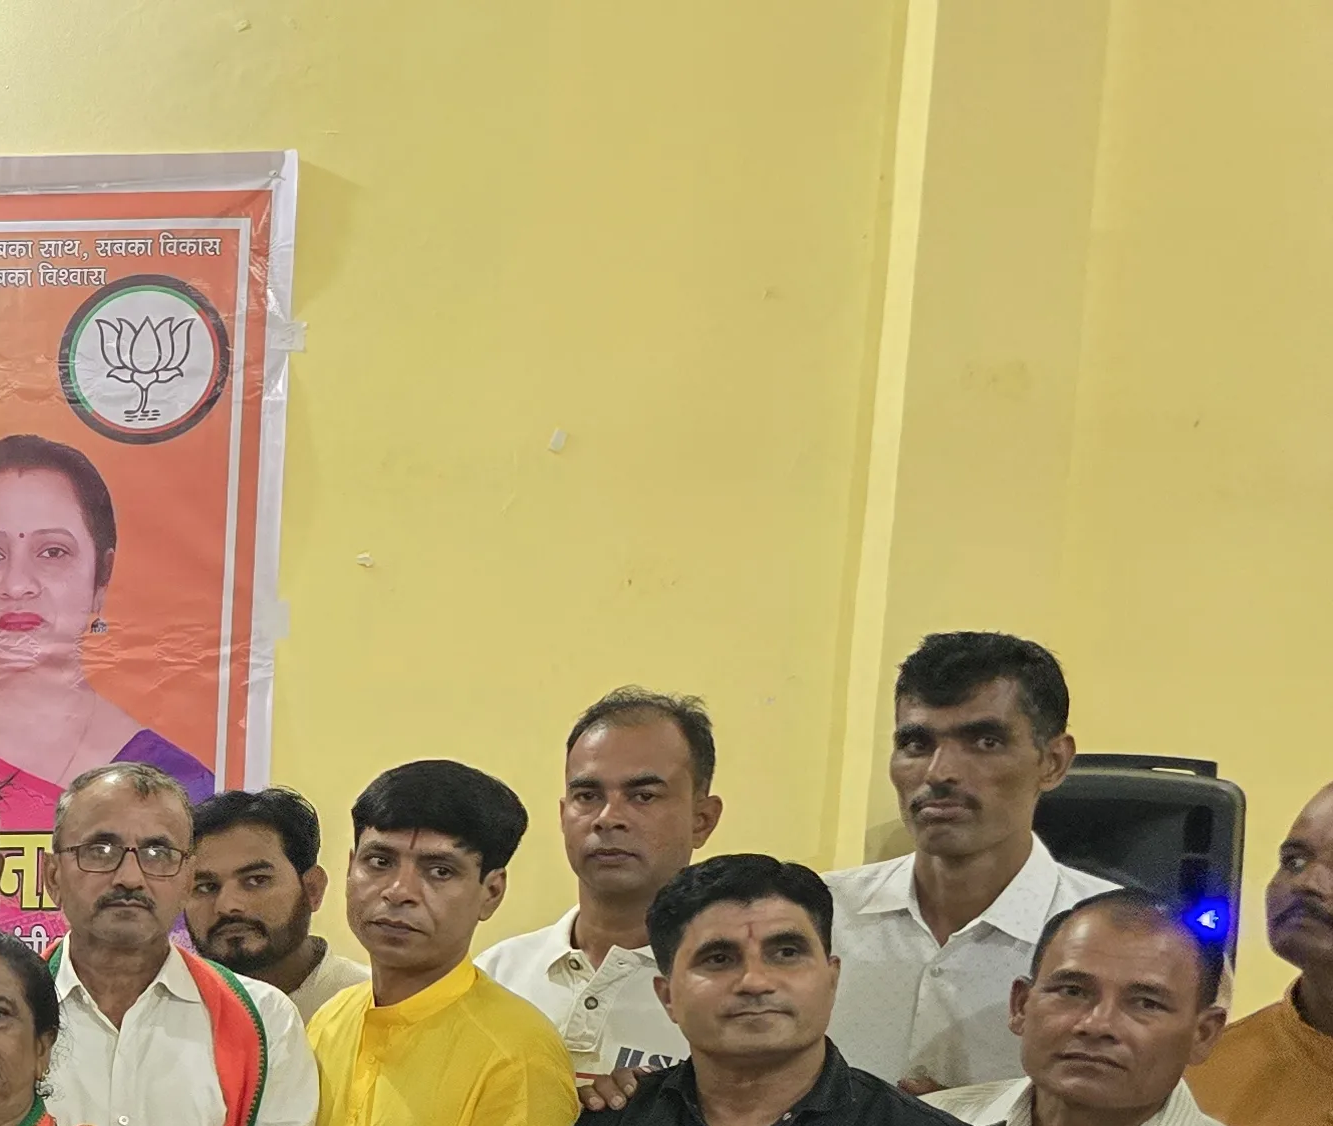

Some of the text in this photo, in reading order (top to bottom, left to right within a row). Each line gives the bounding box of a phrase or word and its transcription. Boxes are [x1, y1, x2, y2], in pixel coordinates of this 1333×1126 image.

[38, 238, 89, 261] साथ,
[95, 237, 152, 258] सबका
[158, 231, 221, 257] विकास
[38, 262, 107, 287] विश्वास
